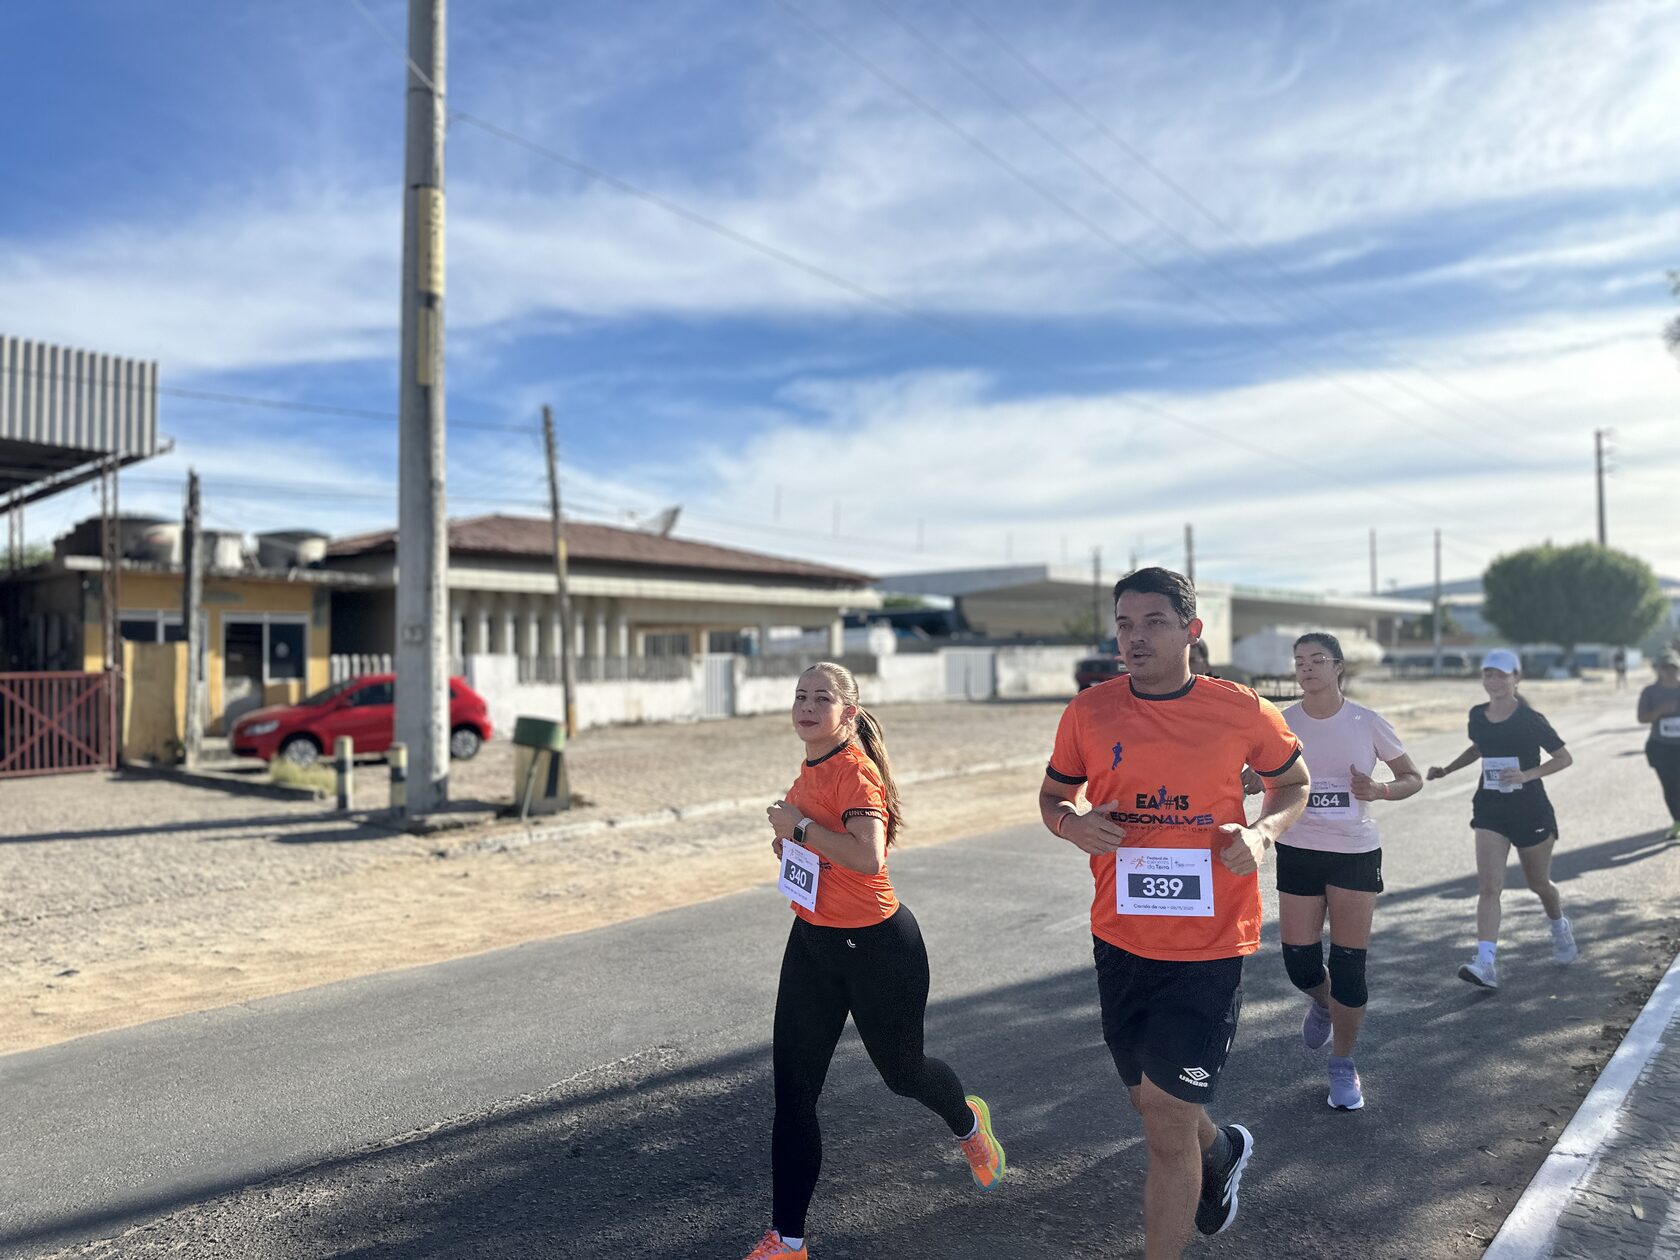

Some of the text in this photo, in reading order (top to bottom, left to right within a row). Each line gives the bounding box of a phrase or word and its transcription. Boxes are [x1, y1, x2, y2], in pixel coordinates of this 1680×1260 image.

[1312, 794, 1340, 807] 064
[1110, 811, 1214, 825] EDSONALVES
[789, 865, 806, 887] 340
[1142, 877, 1183, 897] 339
[1179, 1074, 1208, 1087] UMBRO
